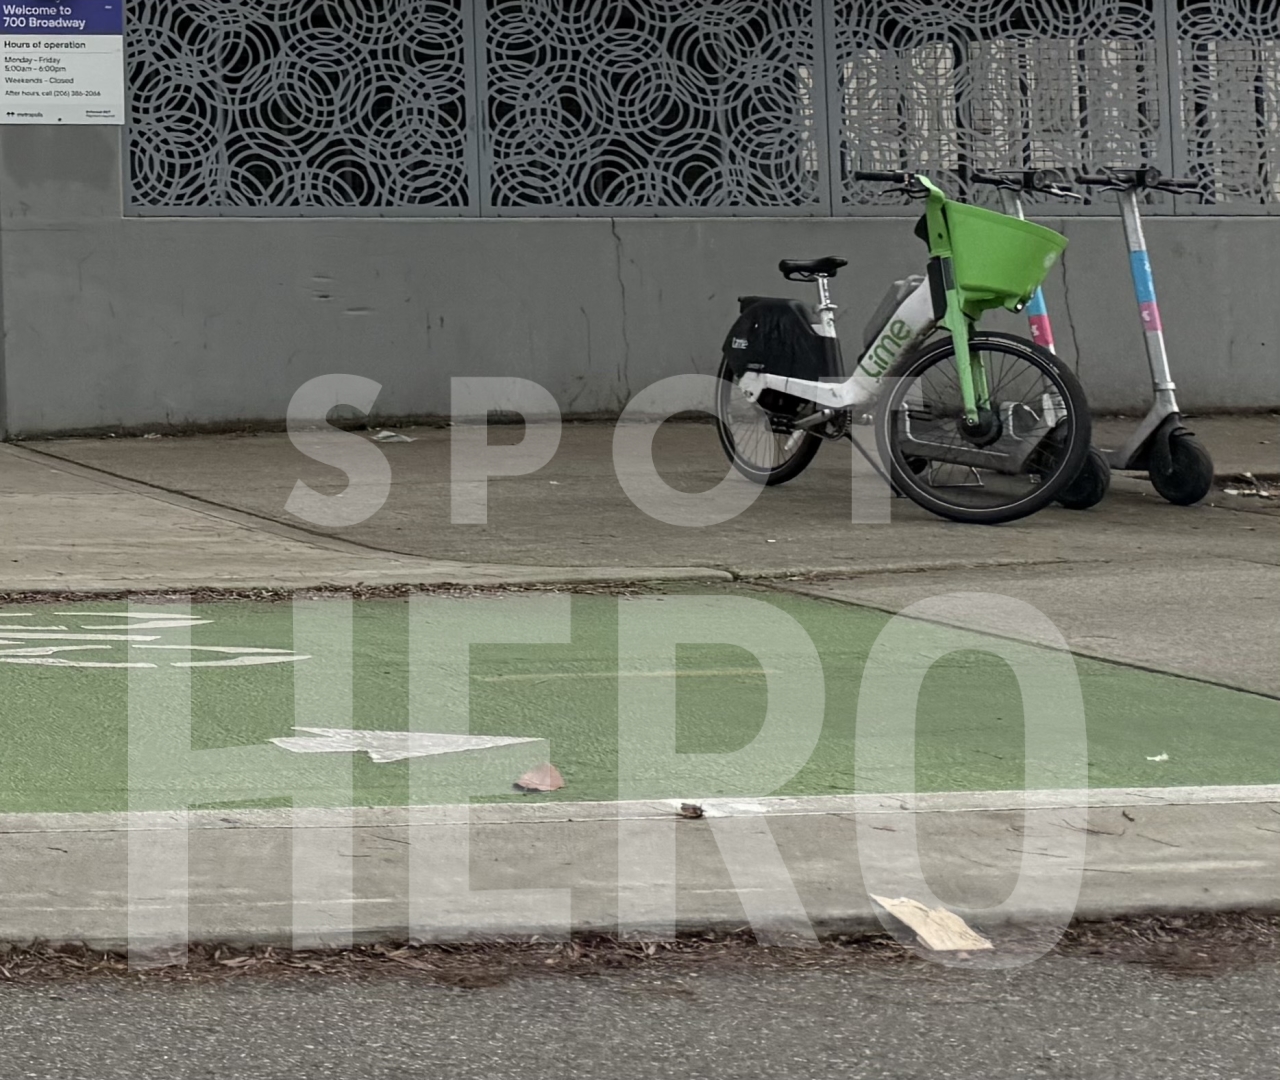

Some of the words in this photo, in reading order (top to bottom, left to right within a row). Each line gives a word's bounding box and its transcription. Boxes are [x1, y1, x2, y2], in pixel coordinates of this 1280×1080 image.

[3, 5, 57, 15] Welcome
[59, 5, 72, 15] to
[3, 17, 26, 27] 700
[29, 17, 86, 30] Broadway
[4, 41, 30, 49] Hours
[32, 41, 41, 49] of
[44, 41, 86, 50] operation
[4, 56, 33, 65] Monday
[38, 56, 61, 65] Friday
[860, 320, 910, 377] Lime
